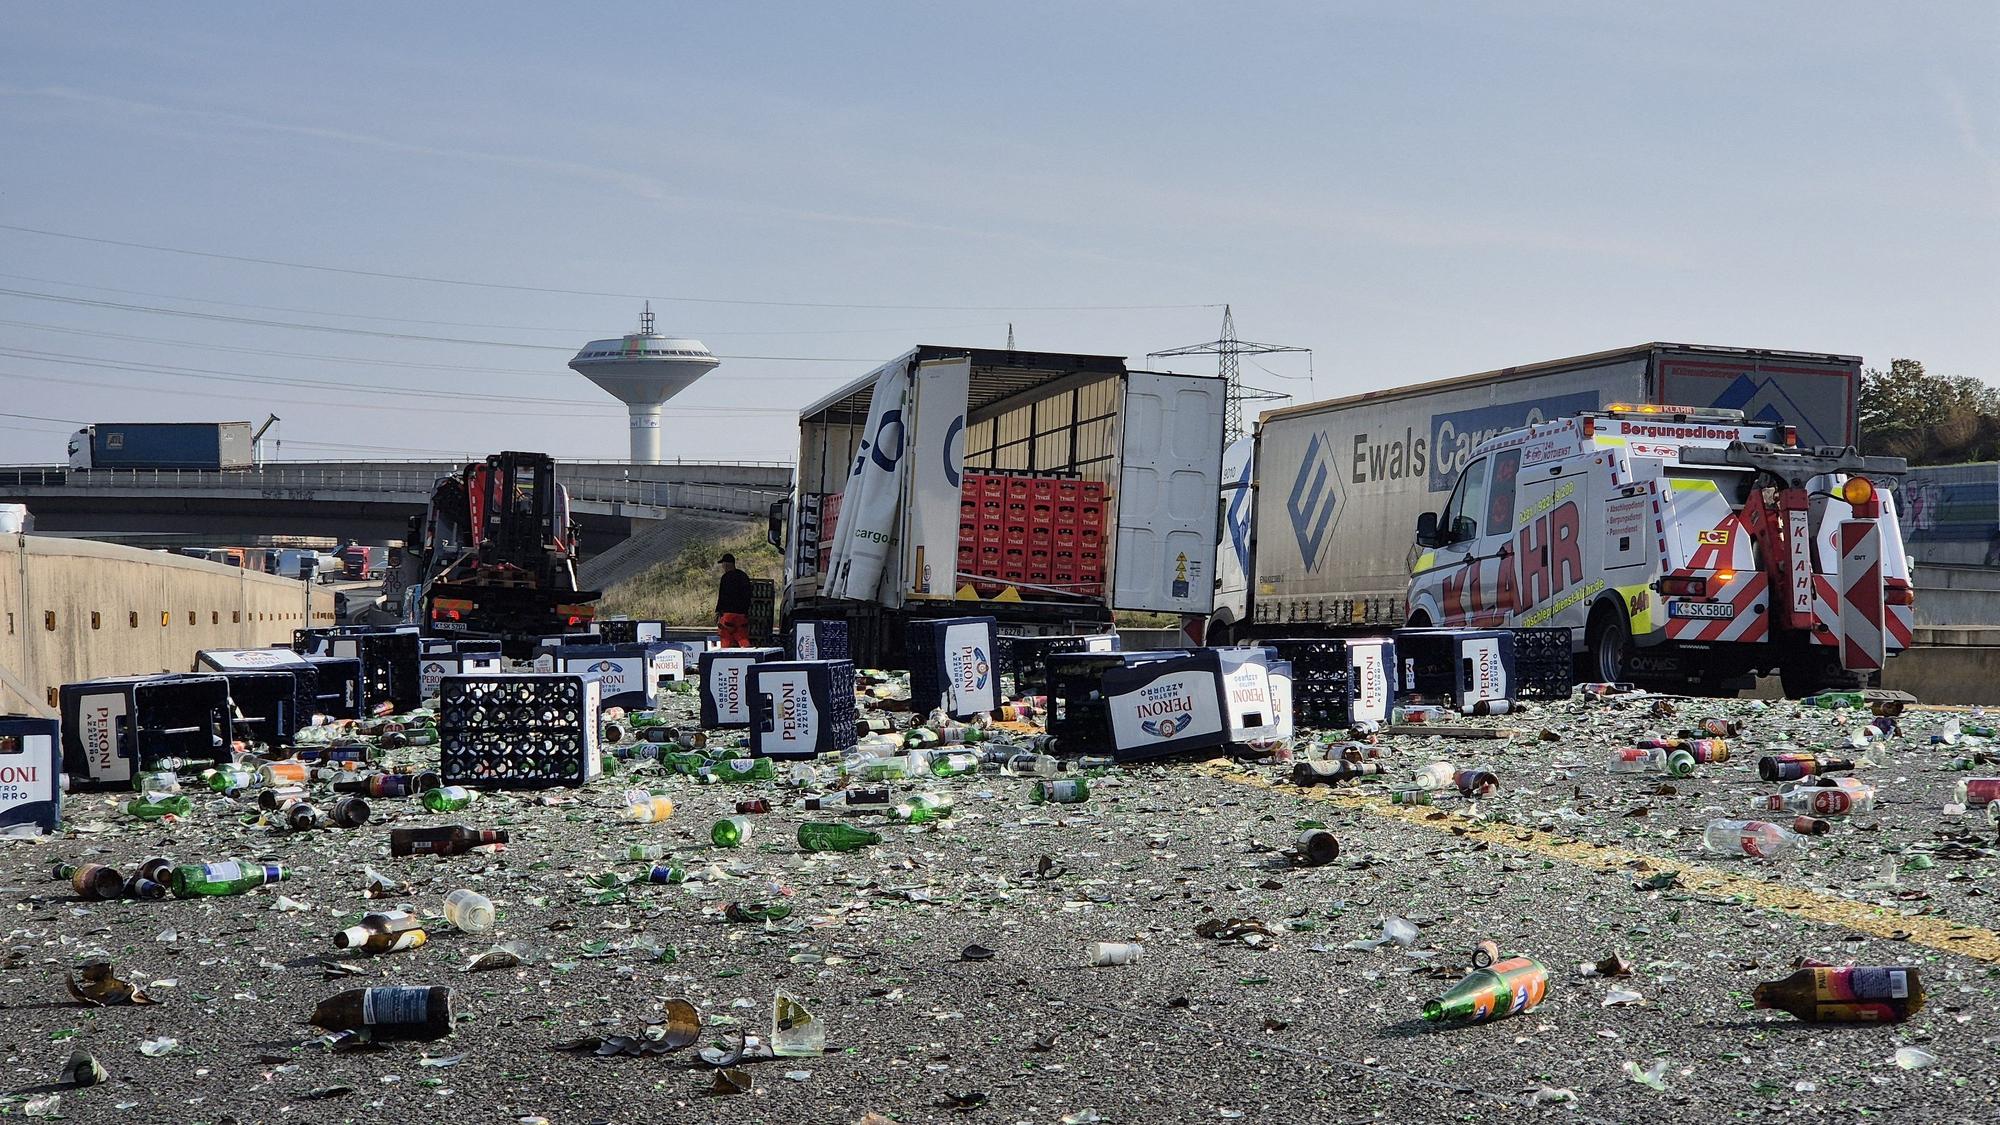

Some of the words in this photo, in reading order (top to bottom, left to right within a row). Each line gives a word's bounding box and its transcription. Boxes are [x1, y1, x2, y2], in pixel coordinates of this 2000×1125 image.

[1663, 406, 1694, 415] KLAHR
[1621, 421, 1740, 440] Bergungsdienst
[1352, 427, 1426, 484] Ewals
[1437, 421, 1512, 475] Car
[1699, 531, 1727, 543] ACE
[1442, 500, 1584, 628] KLAHR
[1793, 526, 1810, 606] KLAHR
[1631, 590, 1650, 617] 24h
[1676, 603, 1685, 616] K
[1690, 603, 1704, 616] SK
[1706, 603, 1733, 616] 5800
[601, 675, 624, 684] RONI
[961, 646, 974, 692] PERONI
[1366, 656, 1374, 708] PERONI
[1480, 648, 1489, 698] PERONI
[728, 667, 739, 714] PERONI
[1137, 695, 1193, 718] PERONI
[1140, 682, 1184, 696] AZZURRO
[1148, 691, 1178, 701] NASTRO
[1232, 688, 1265, 703] PERONI
[783, 682, 796, 740] PERONI
[801, 689, 809, 735] AZZURRO
[87, 713, 95, 763] AZZURRO
[97, 707, 111, 769] PERONI
[0, 766, 37, 783] ONI
